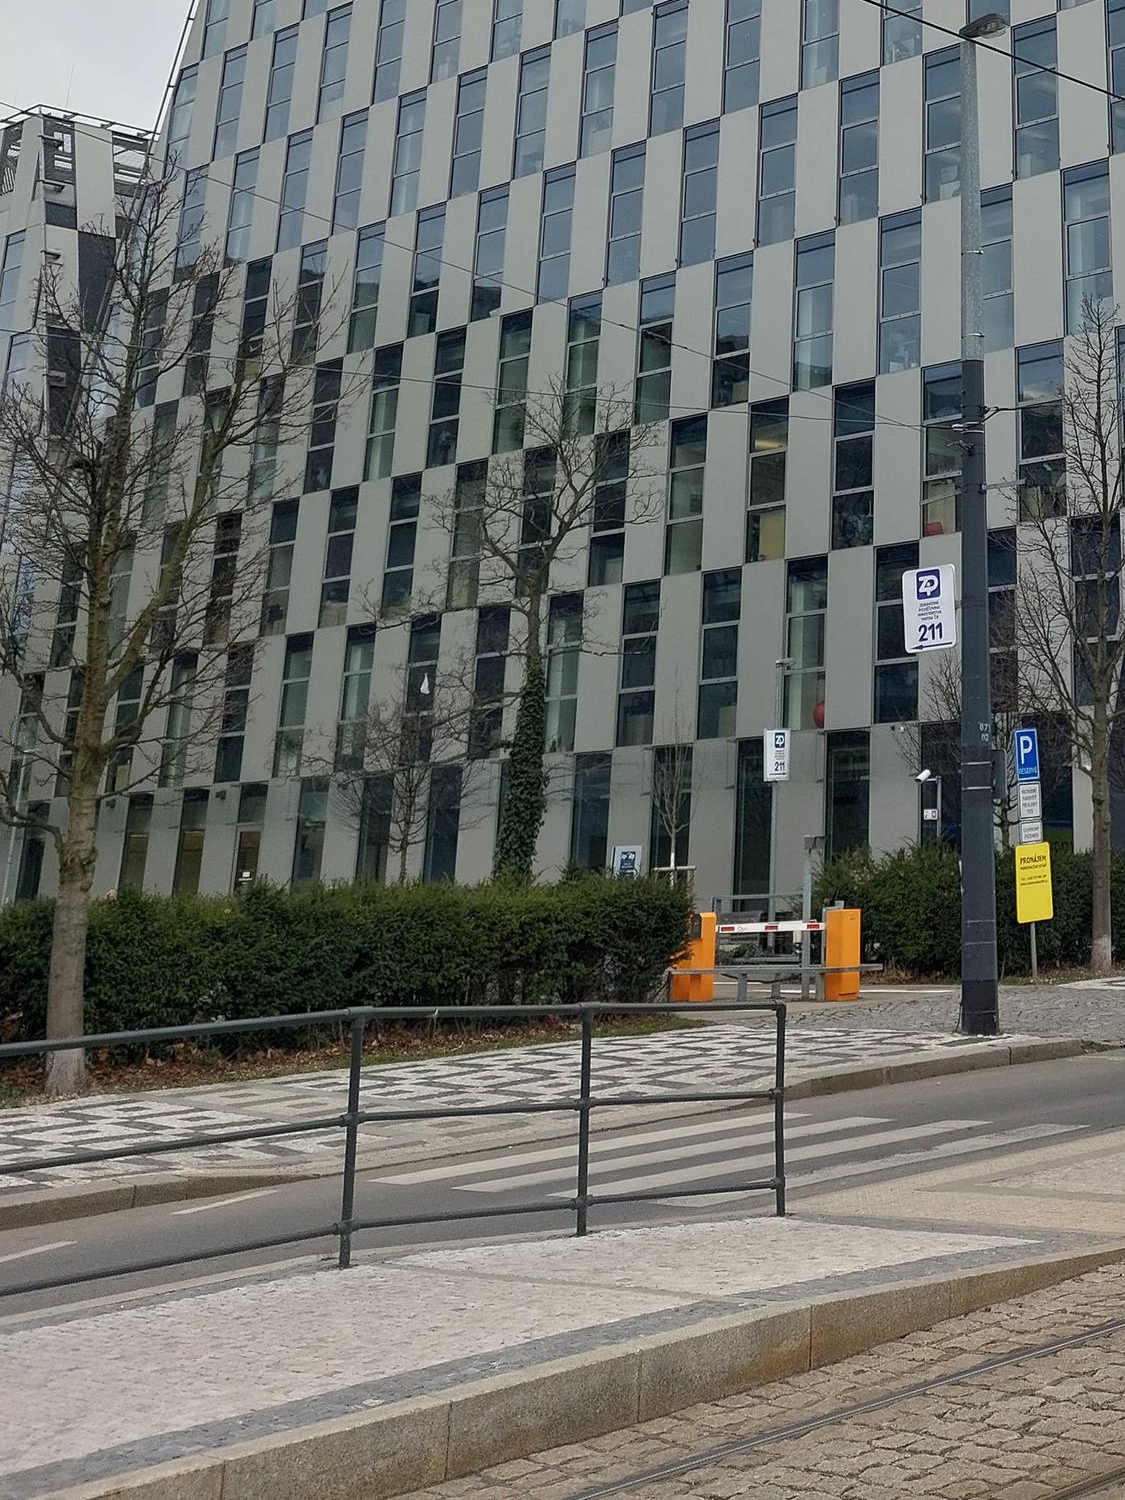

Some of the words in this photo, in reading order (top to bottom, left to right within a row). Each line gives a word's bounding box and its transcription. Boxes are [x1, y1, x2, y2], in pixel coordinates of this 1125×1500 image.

[918, 622, 943, 642] 211
[1020, 735, 1033, 765] P
[774, 761, 785, 772] 211
